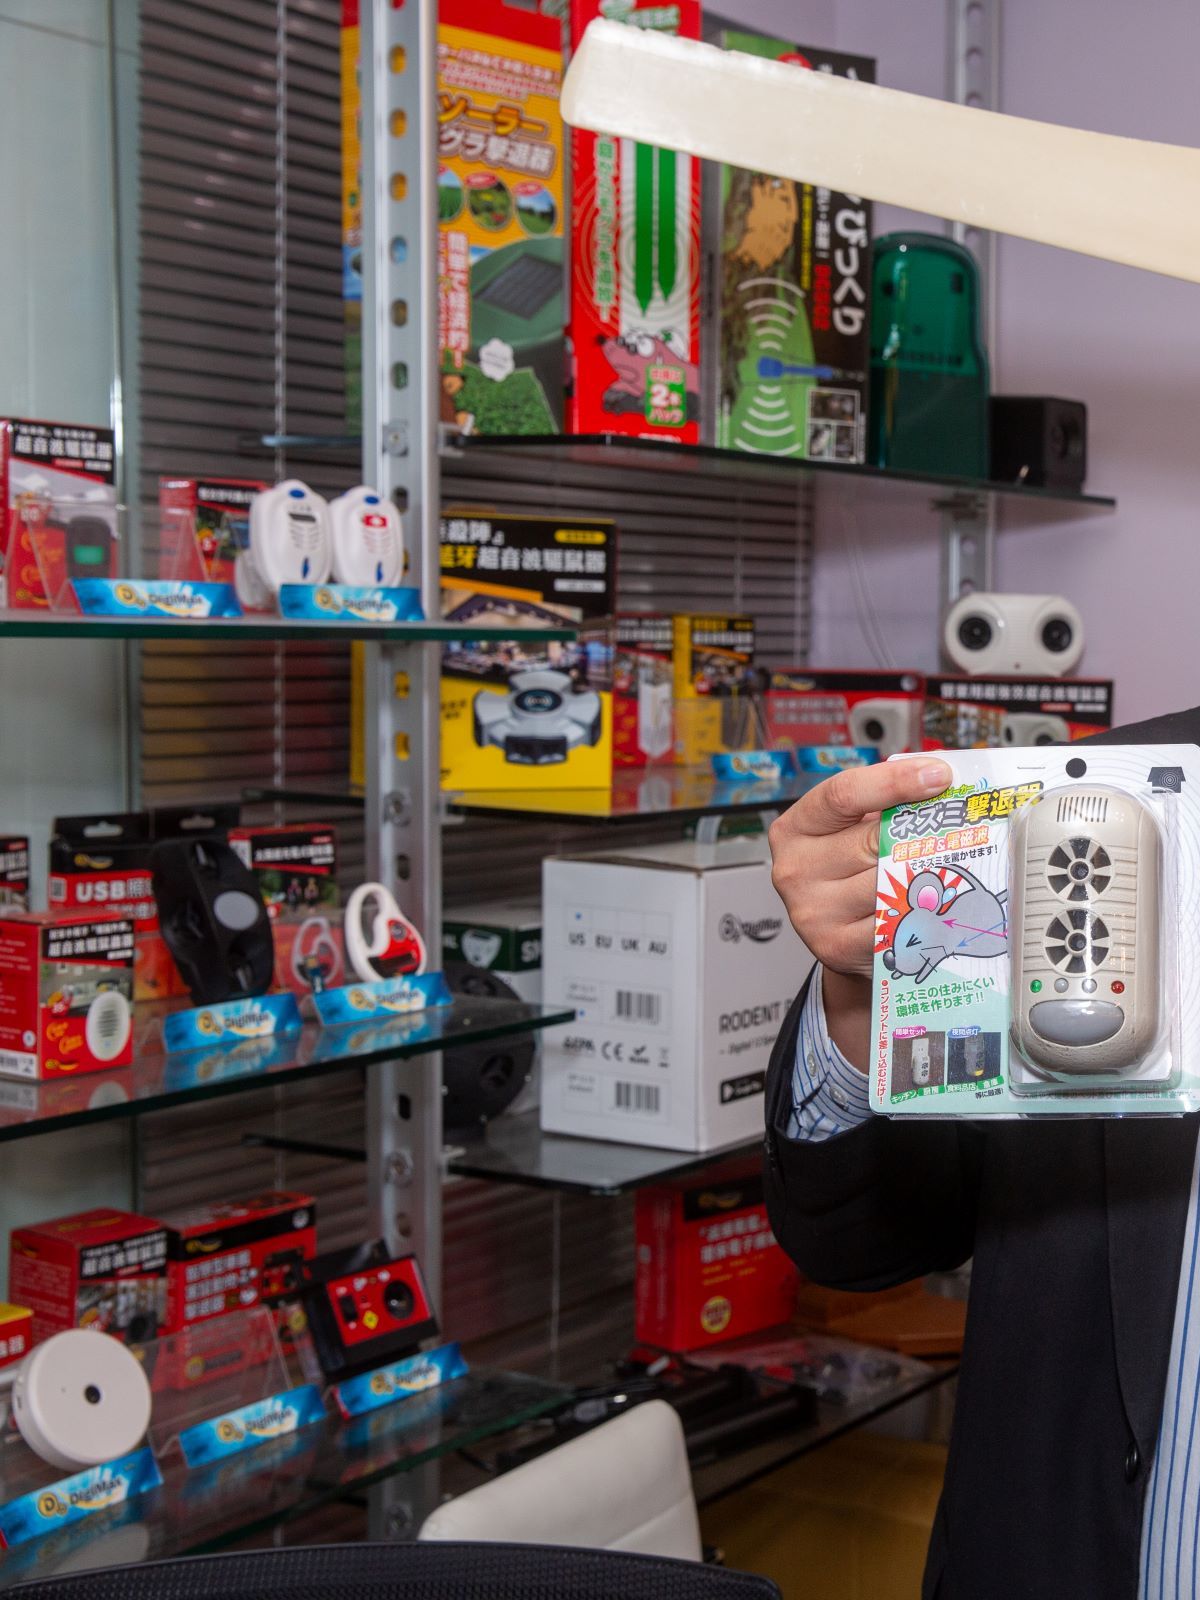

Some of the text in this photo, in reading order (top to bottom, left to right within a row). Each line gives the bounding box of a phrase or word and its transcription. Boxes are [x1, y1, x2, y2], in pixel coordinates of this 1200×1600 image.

[889, 779, 1044, 839] ネズミ撃退器
[895, 976, 995, 1005] ネズミの住みにくい
[719, 1002, 780, 1034] RODENT
